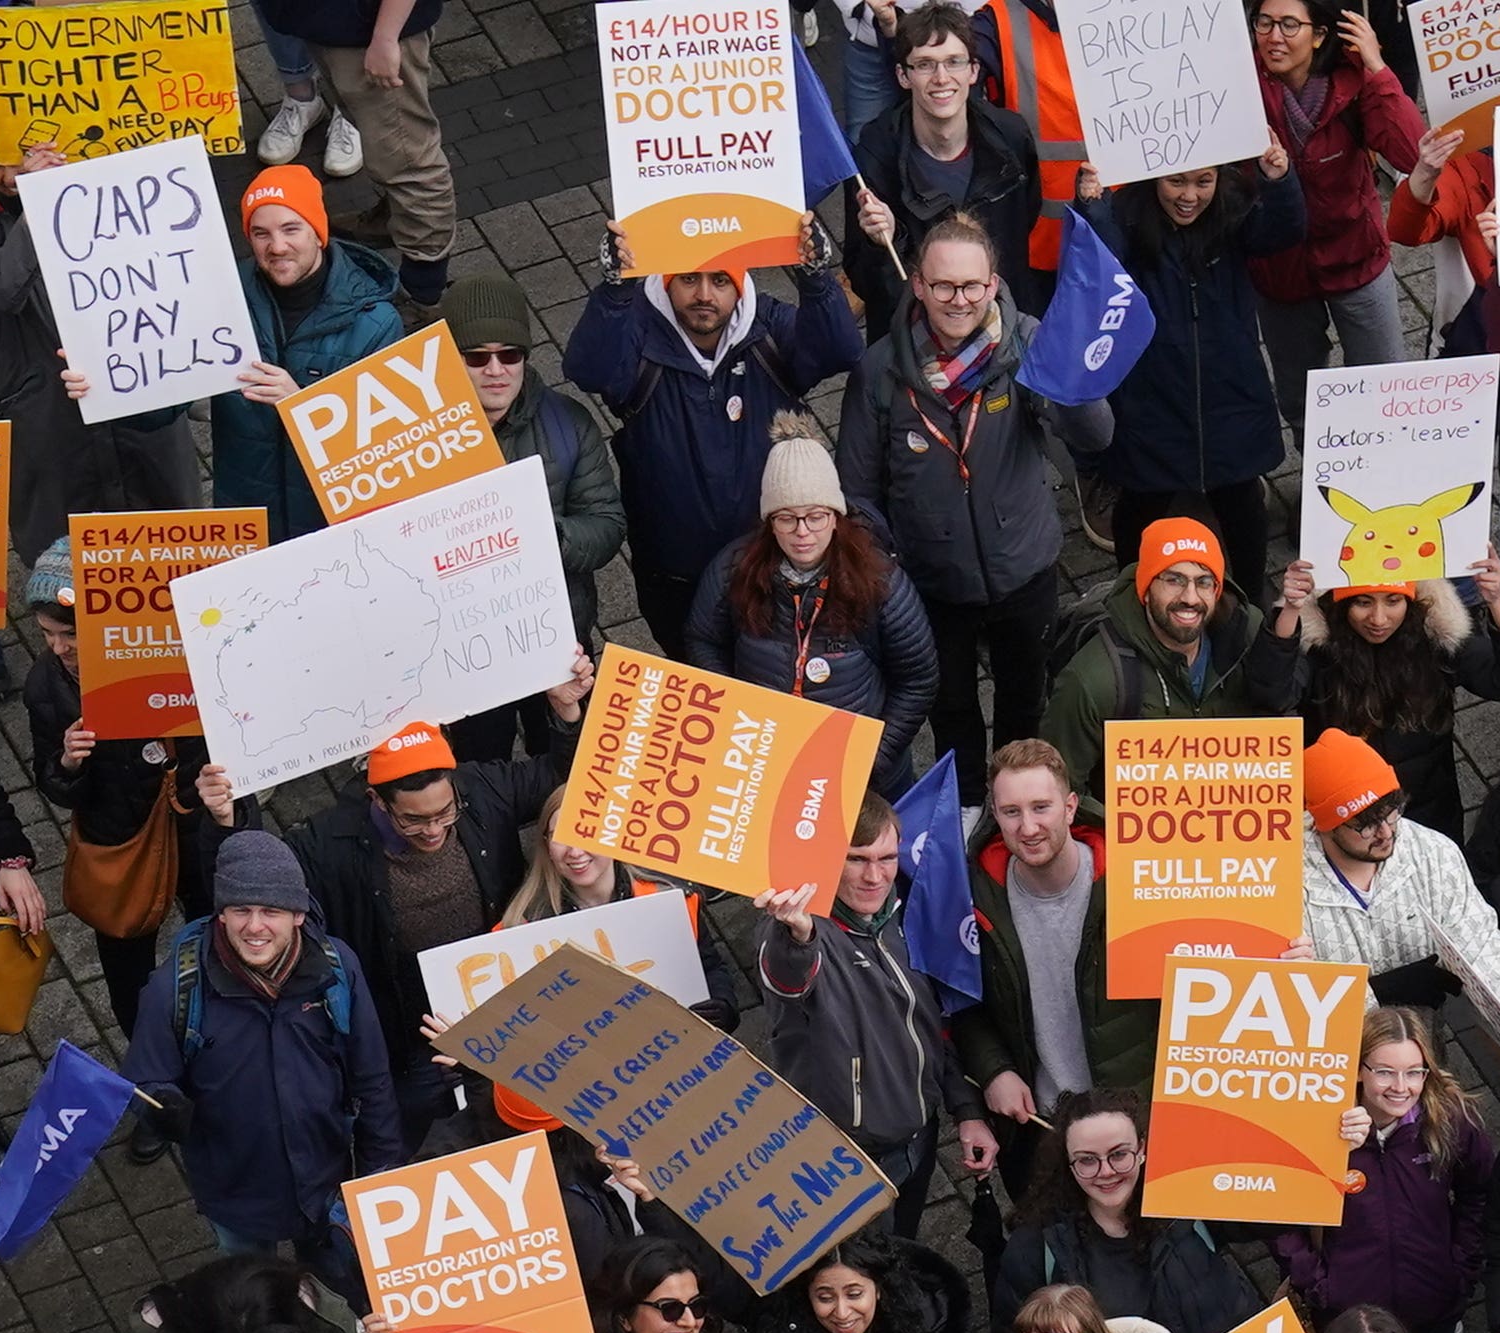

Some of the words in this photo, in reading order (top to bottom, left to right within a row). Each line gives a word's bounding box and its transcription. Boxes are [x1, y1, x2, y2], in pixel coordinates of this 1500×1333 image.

[610, 11, 748, 41] £14/HOUR
[757, 9, 779, 29] IS
[1078, 1, 1220, 67] BARCLAY
[611, 44, 651, 62] NOT
[658, 44, 671, 59] A
[677, 39, 719, 57] FAIR
[724, 35, 781, 52] WAGE
[613, 66, 662, 87] FOR
[671, 64, 686, 83] A
[692, 56, 783, 85] JUNIOR
[1102, 62, 1152, 108] IS
[1178, 52, 1200, 88] A
[118, 84, 148, 113] A
[615, 80, 786, 123] DOCTOR
[108, 112, 164, 130] NEED
[1093, 89, 1227, 146] NAUGHTY
[636, 136, 713, 162] FULL
[721, 130, 773, 156] PAY
[1141, 129, 1201, 171] BOY
[638, 159, 737, 178] RESTORATION
[742, 157, 775, 170] NOW
[53, 167, 202, 262] CLAPS
[700, 216, 742, 234] BMA
[68, 249, 194, 311] DON'T
[107, 300, 179, 347] PAY
[107, 327, 242, 393] BILLS
[1317, 379, 1372, 407] govt:
[1382, 397, 1463, 417] doctors
[1317, 426, 1393, 449] doctors:
[1315, 456, 1371, 483] govt:
